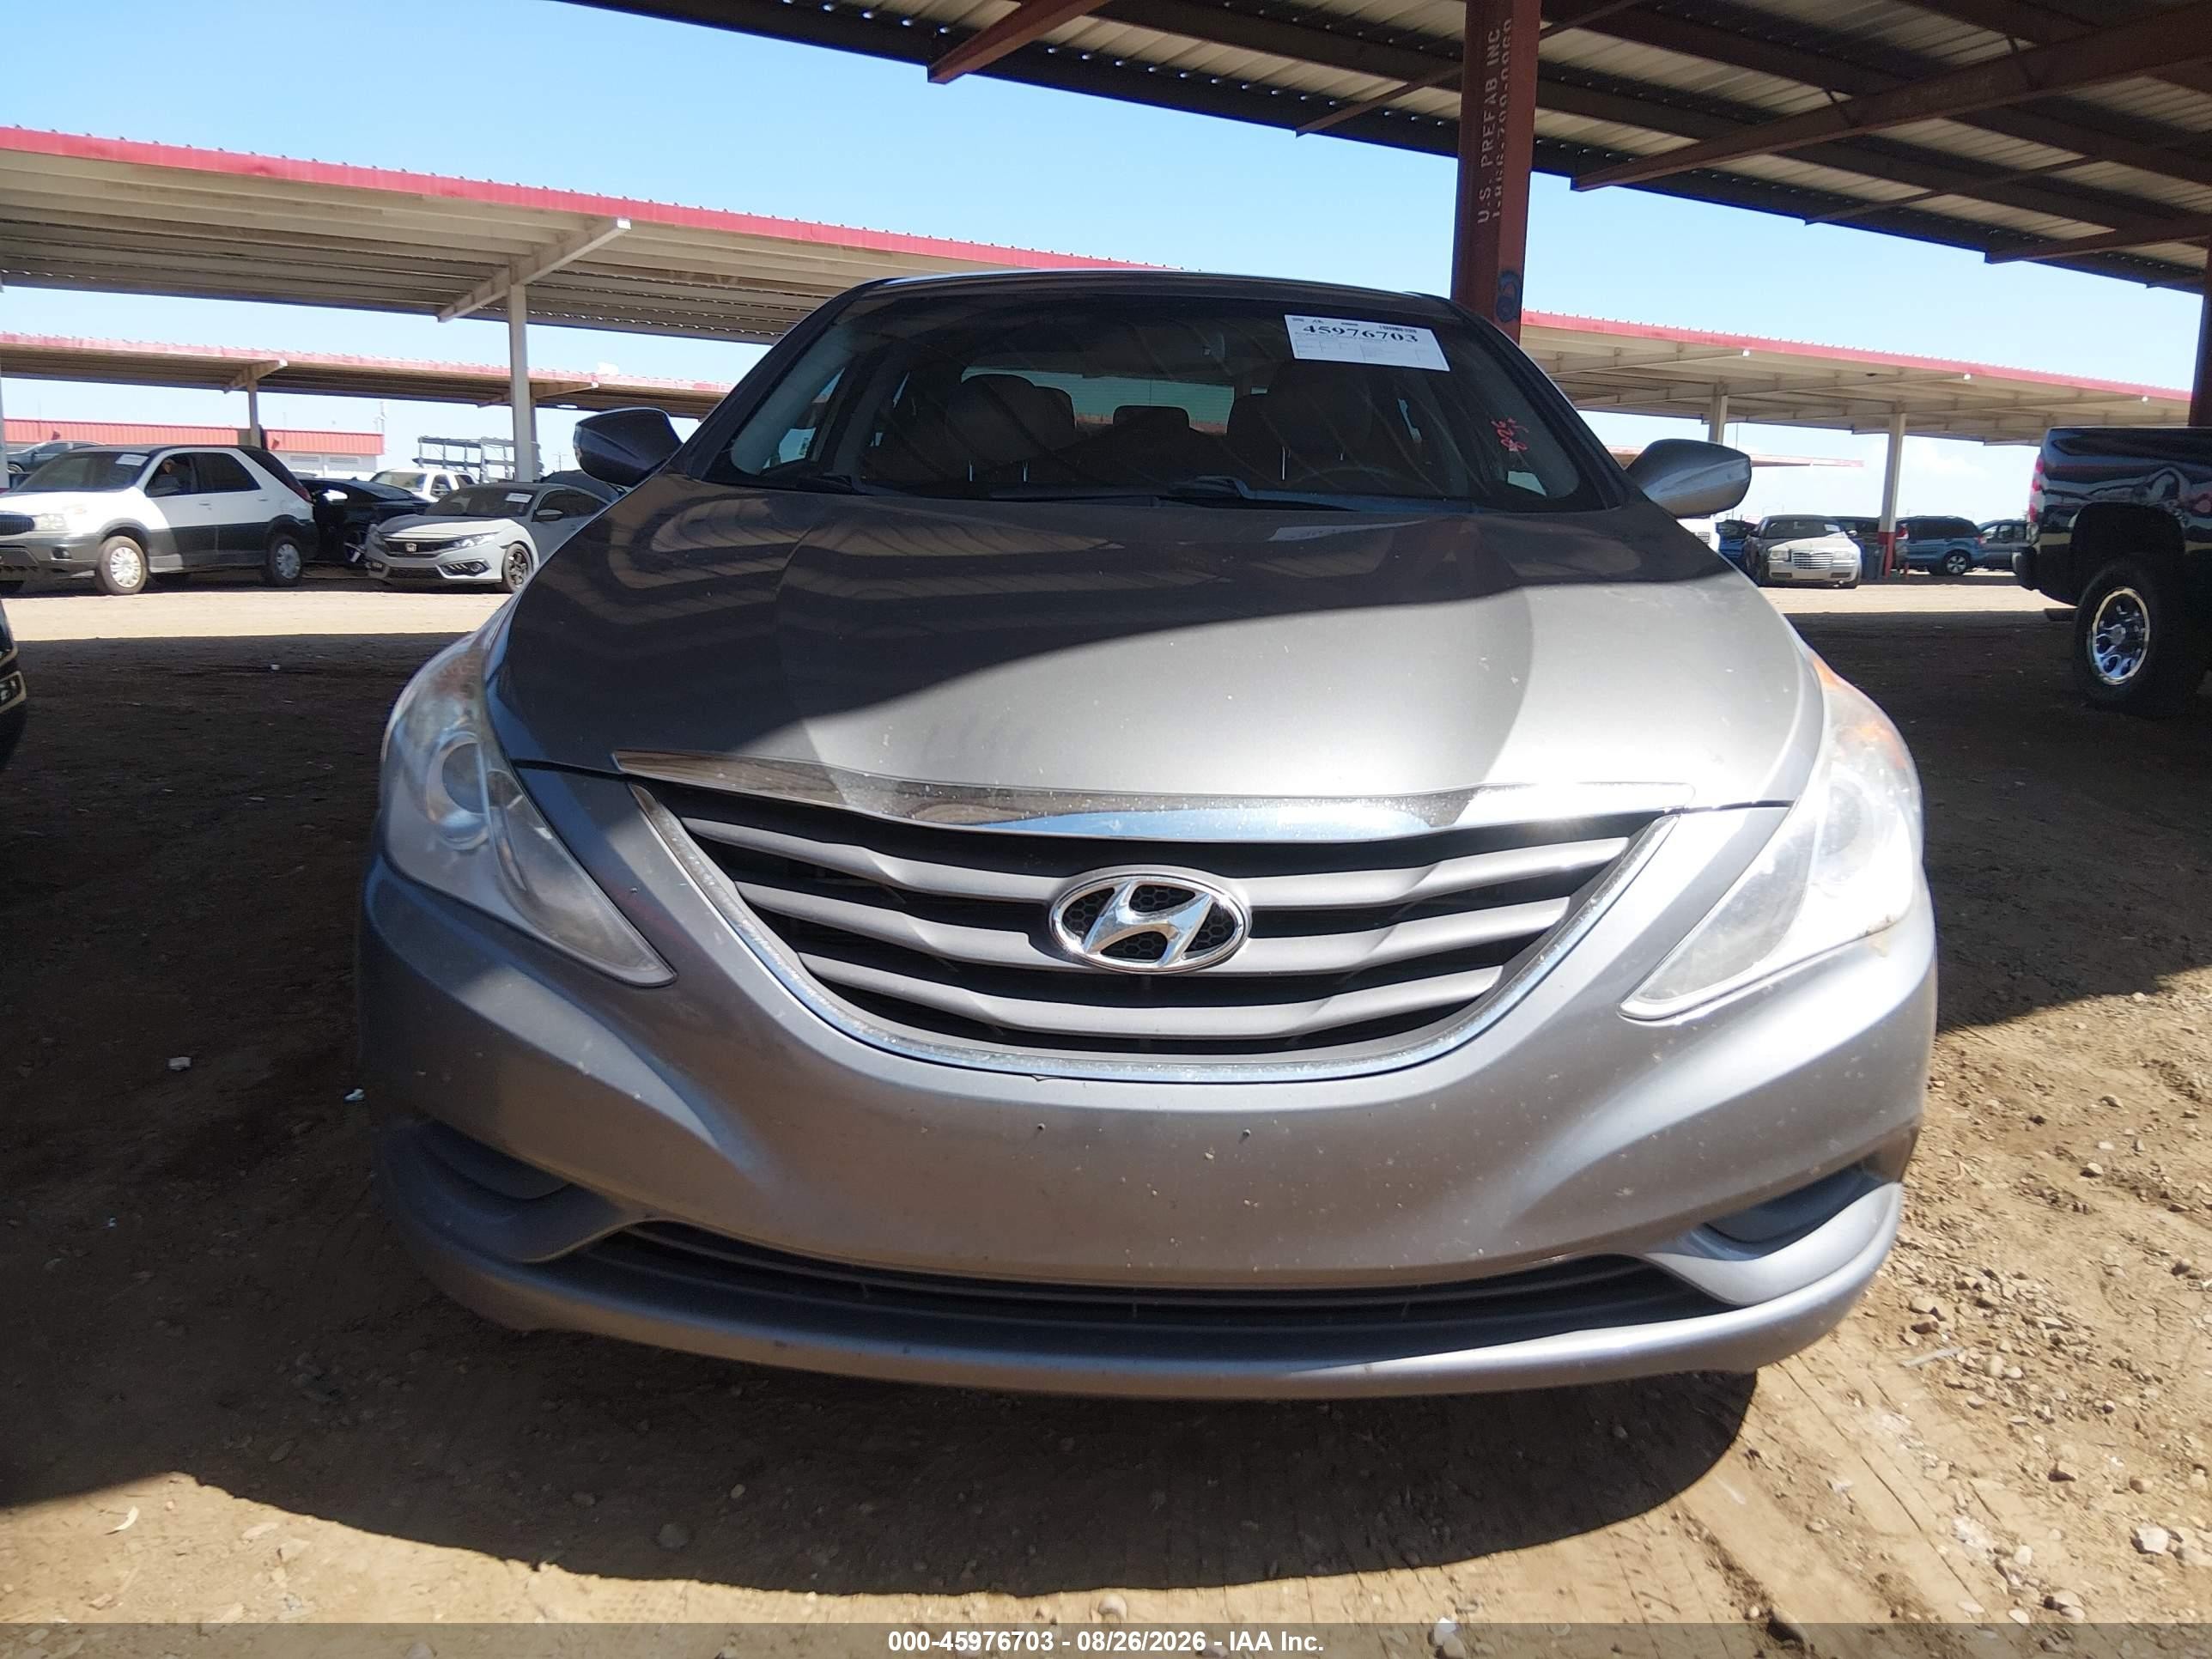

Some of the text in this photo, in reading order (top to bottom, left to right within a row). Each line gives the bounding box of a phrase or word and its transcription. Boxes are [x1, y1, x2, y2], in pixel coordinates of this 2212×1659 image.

[1480, 76, 1498, 169] PREFAB
[1477, 178, 1492, 224] U.S.
[1303, 324, 1419, 343] 45976703
